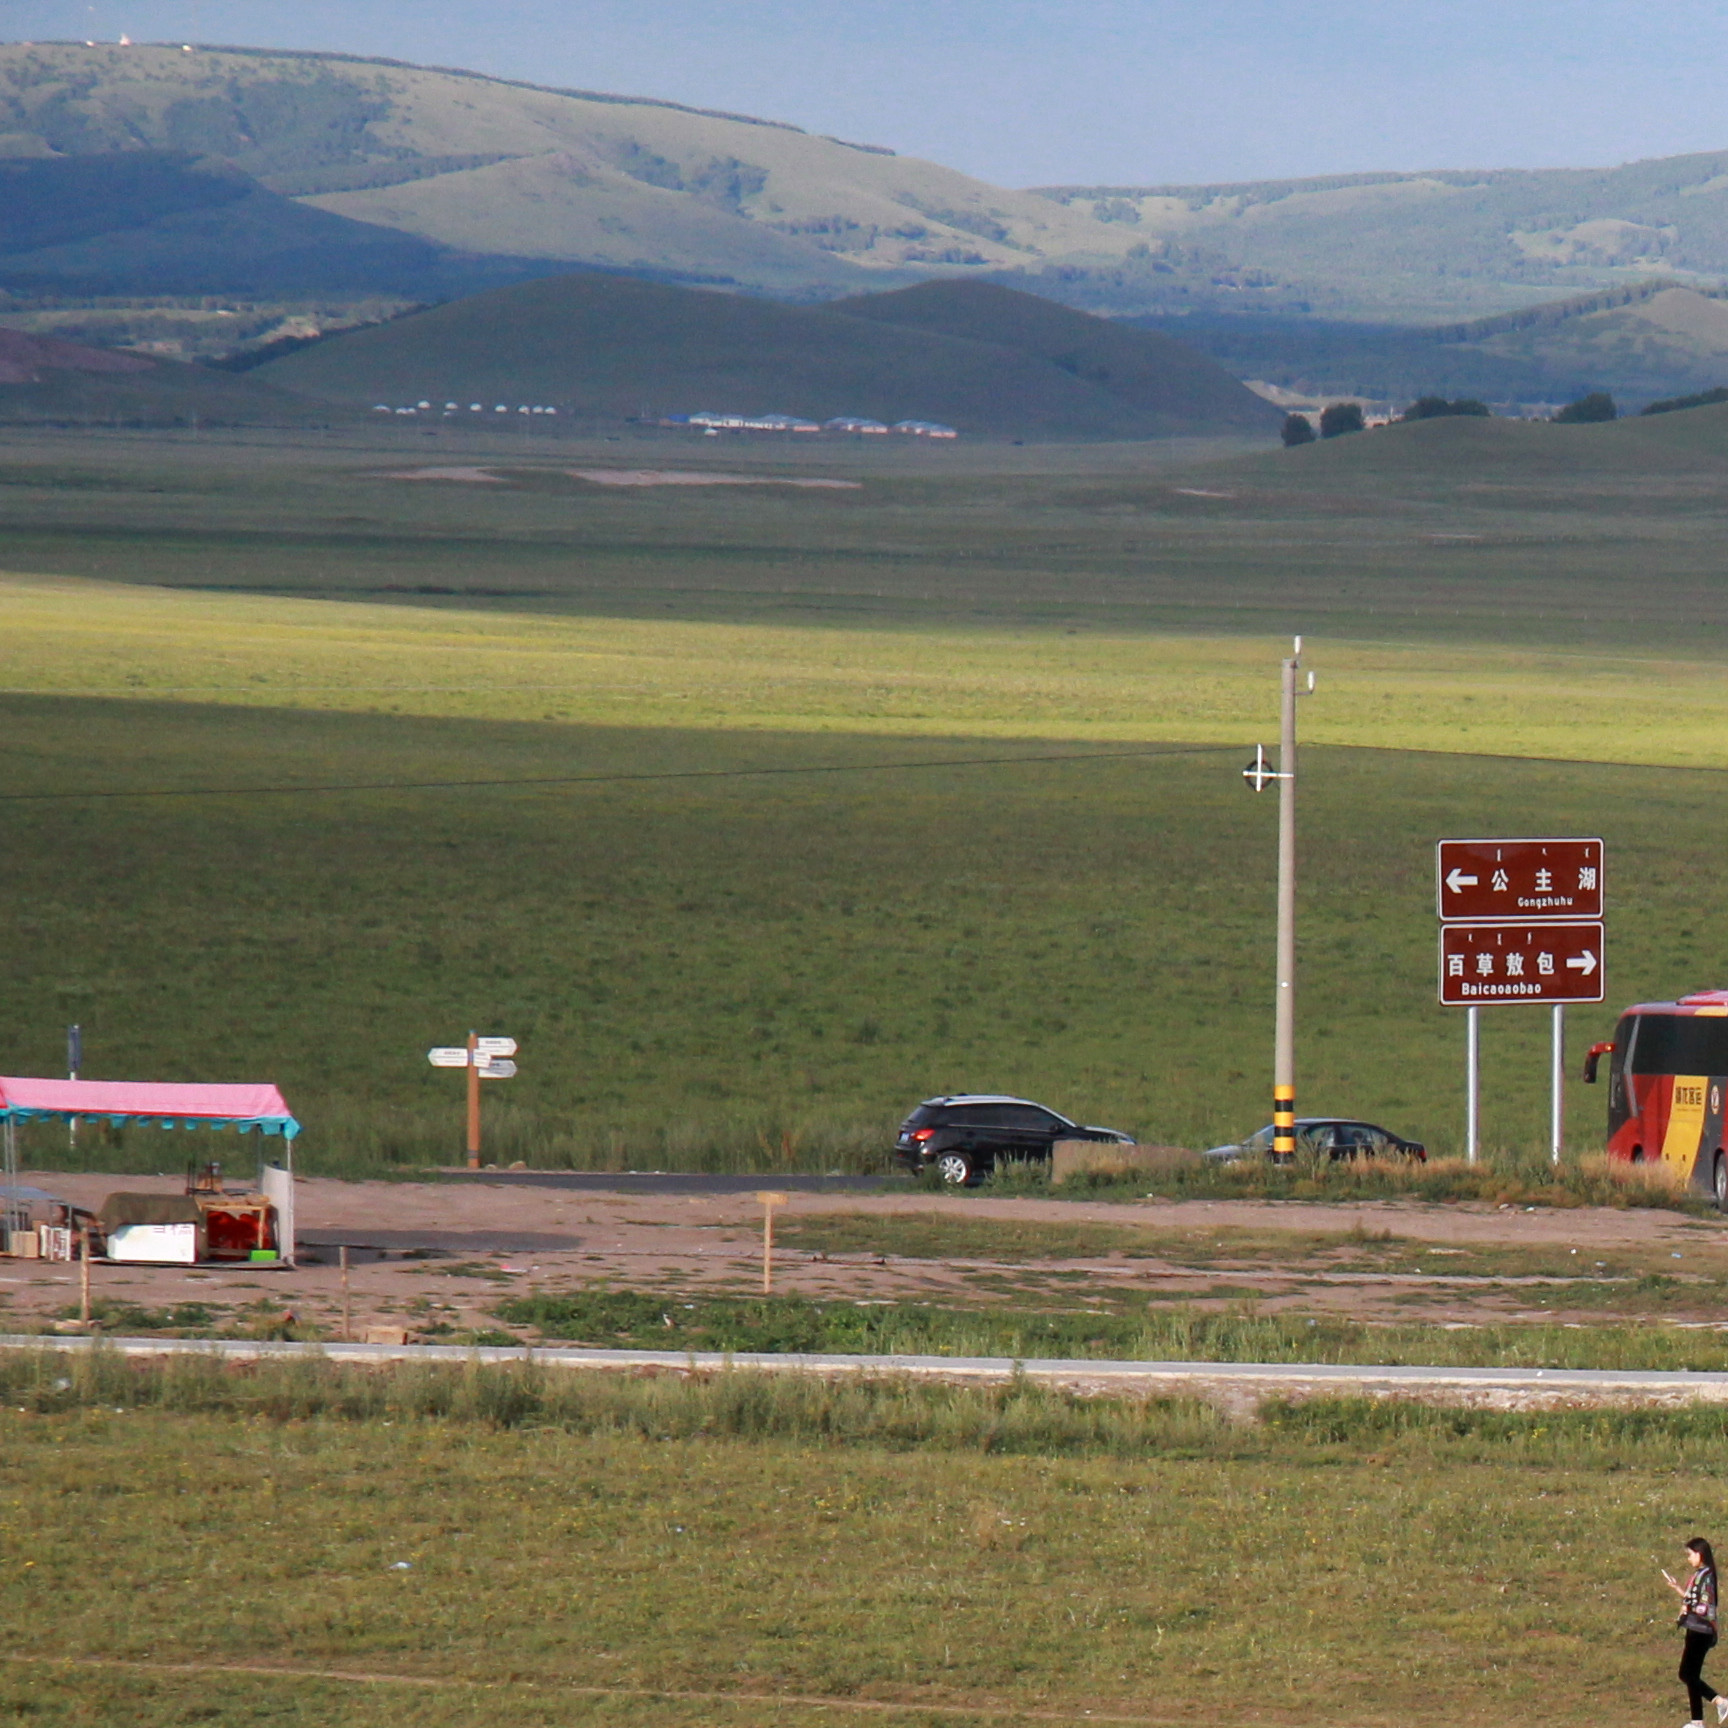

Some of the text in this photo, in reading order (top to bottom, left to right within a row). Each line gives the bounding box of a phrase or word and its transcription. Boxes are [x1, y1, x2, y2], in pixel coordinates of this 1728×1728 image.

[1491, 867, 1597, 892] 公主湖
[1517, 896, 1574, 910] Gongzhuhu
[1447, 951, 1555, 977] 百草敖包
[1461, 982, 1542, 996] Baicaoaobao
